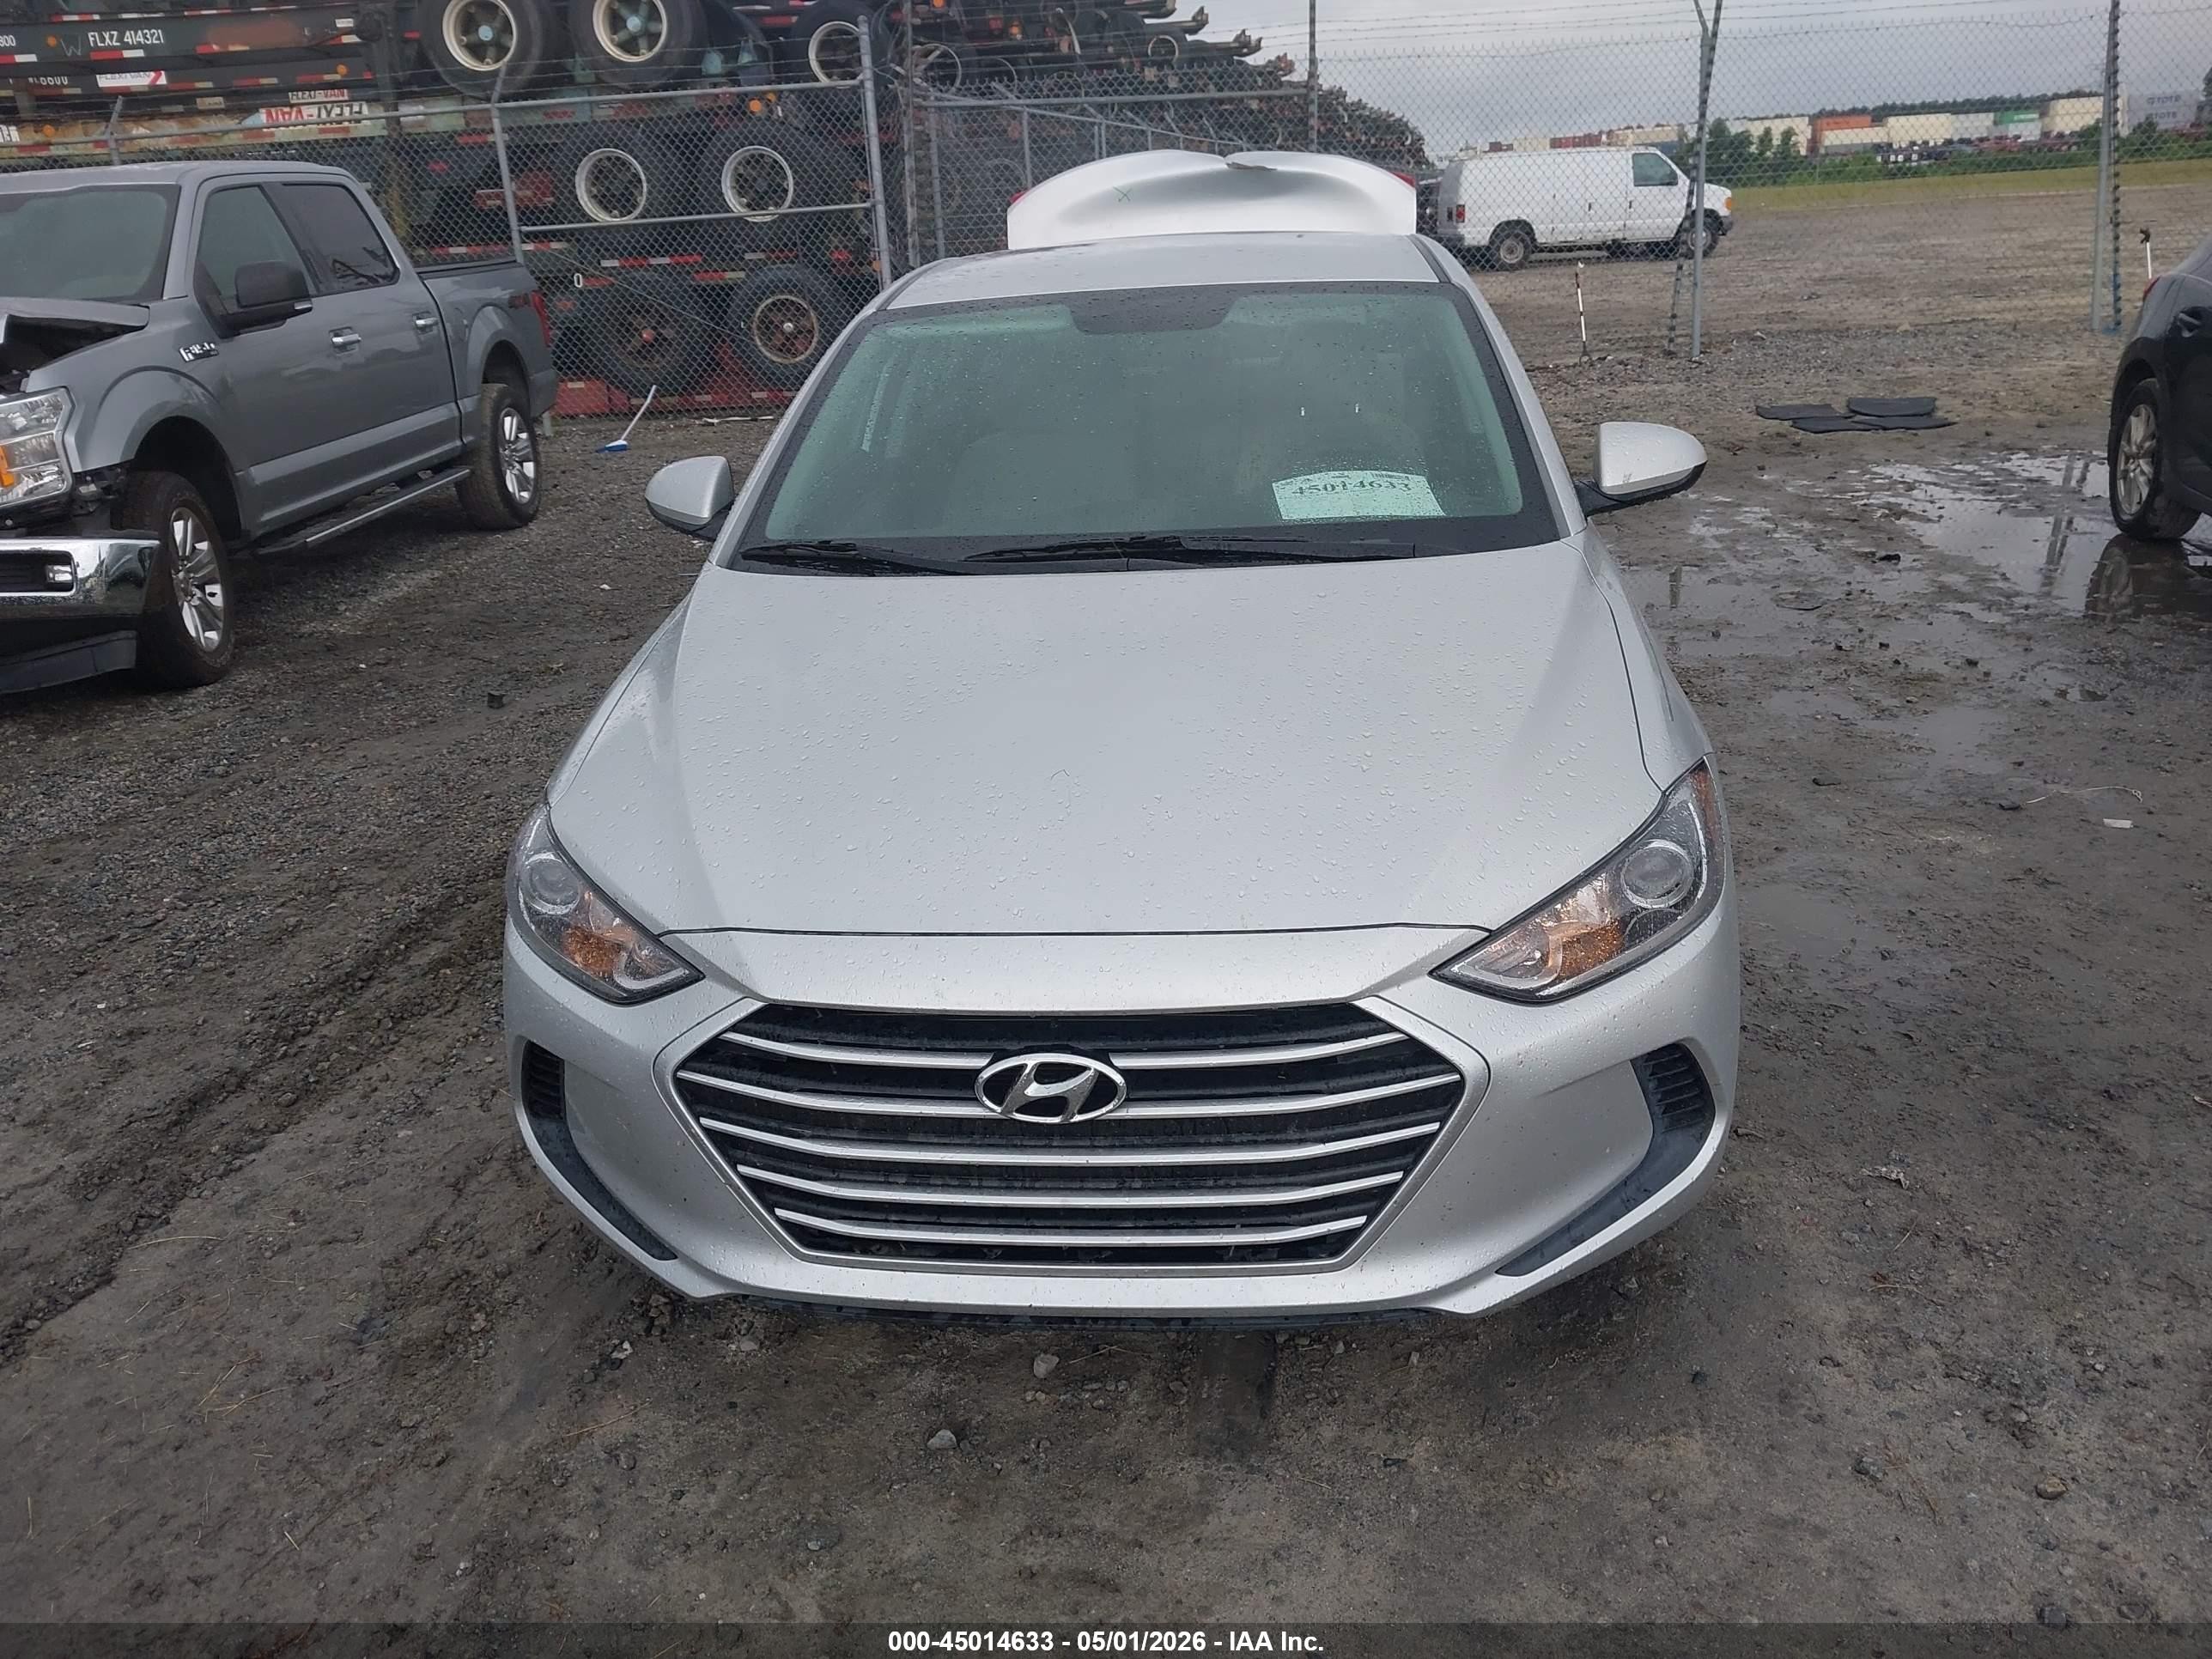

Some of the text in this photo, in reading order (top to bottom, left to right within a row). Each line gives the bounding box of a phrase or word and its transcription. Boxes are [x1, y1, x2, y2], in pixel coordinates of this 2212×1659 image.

[88, 29, 164, 46] FLXZ 414321
[1291, 479, 1412, 495] 45014633
